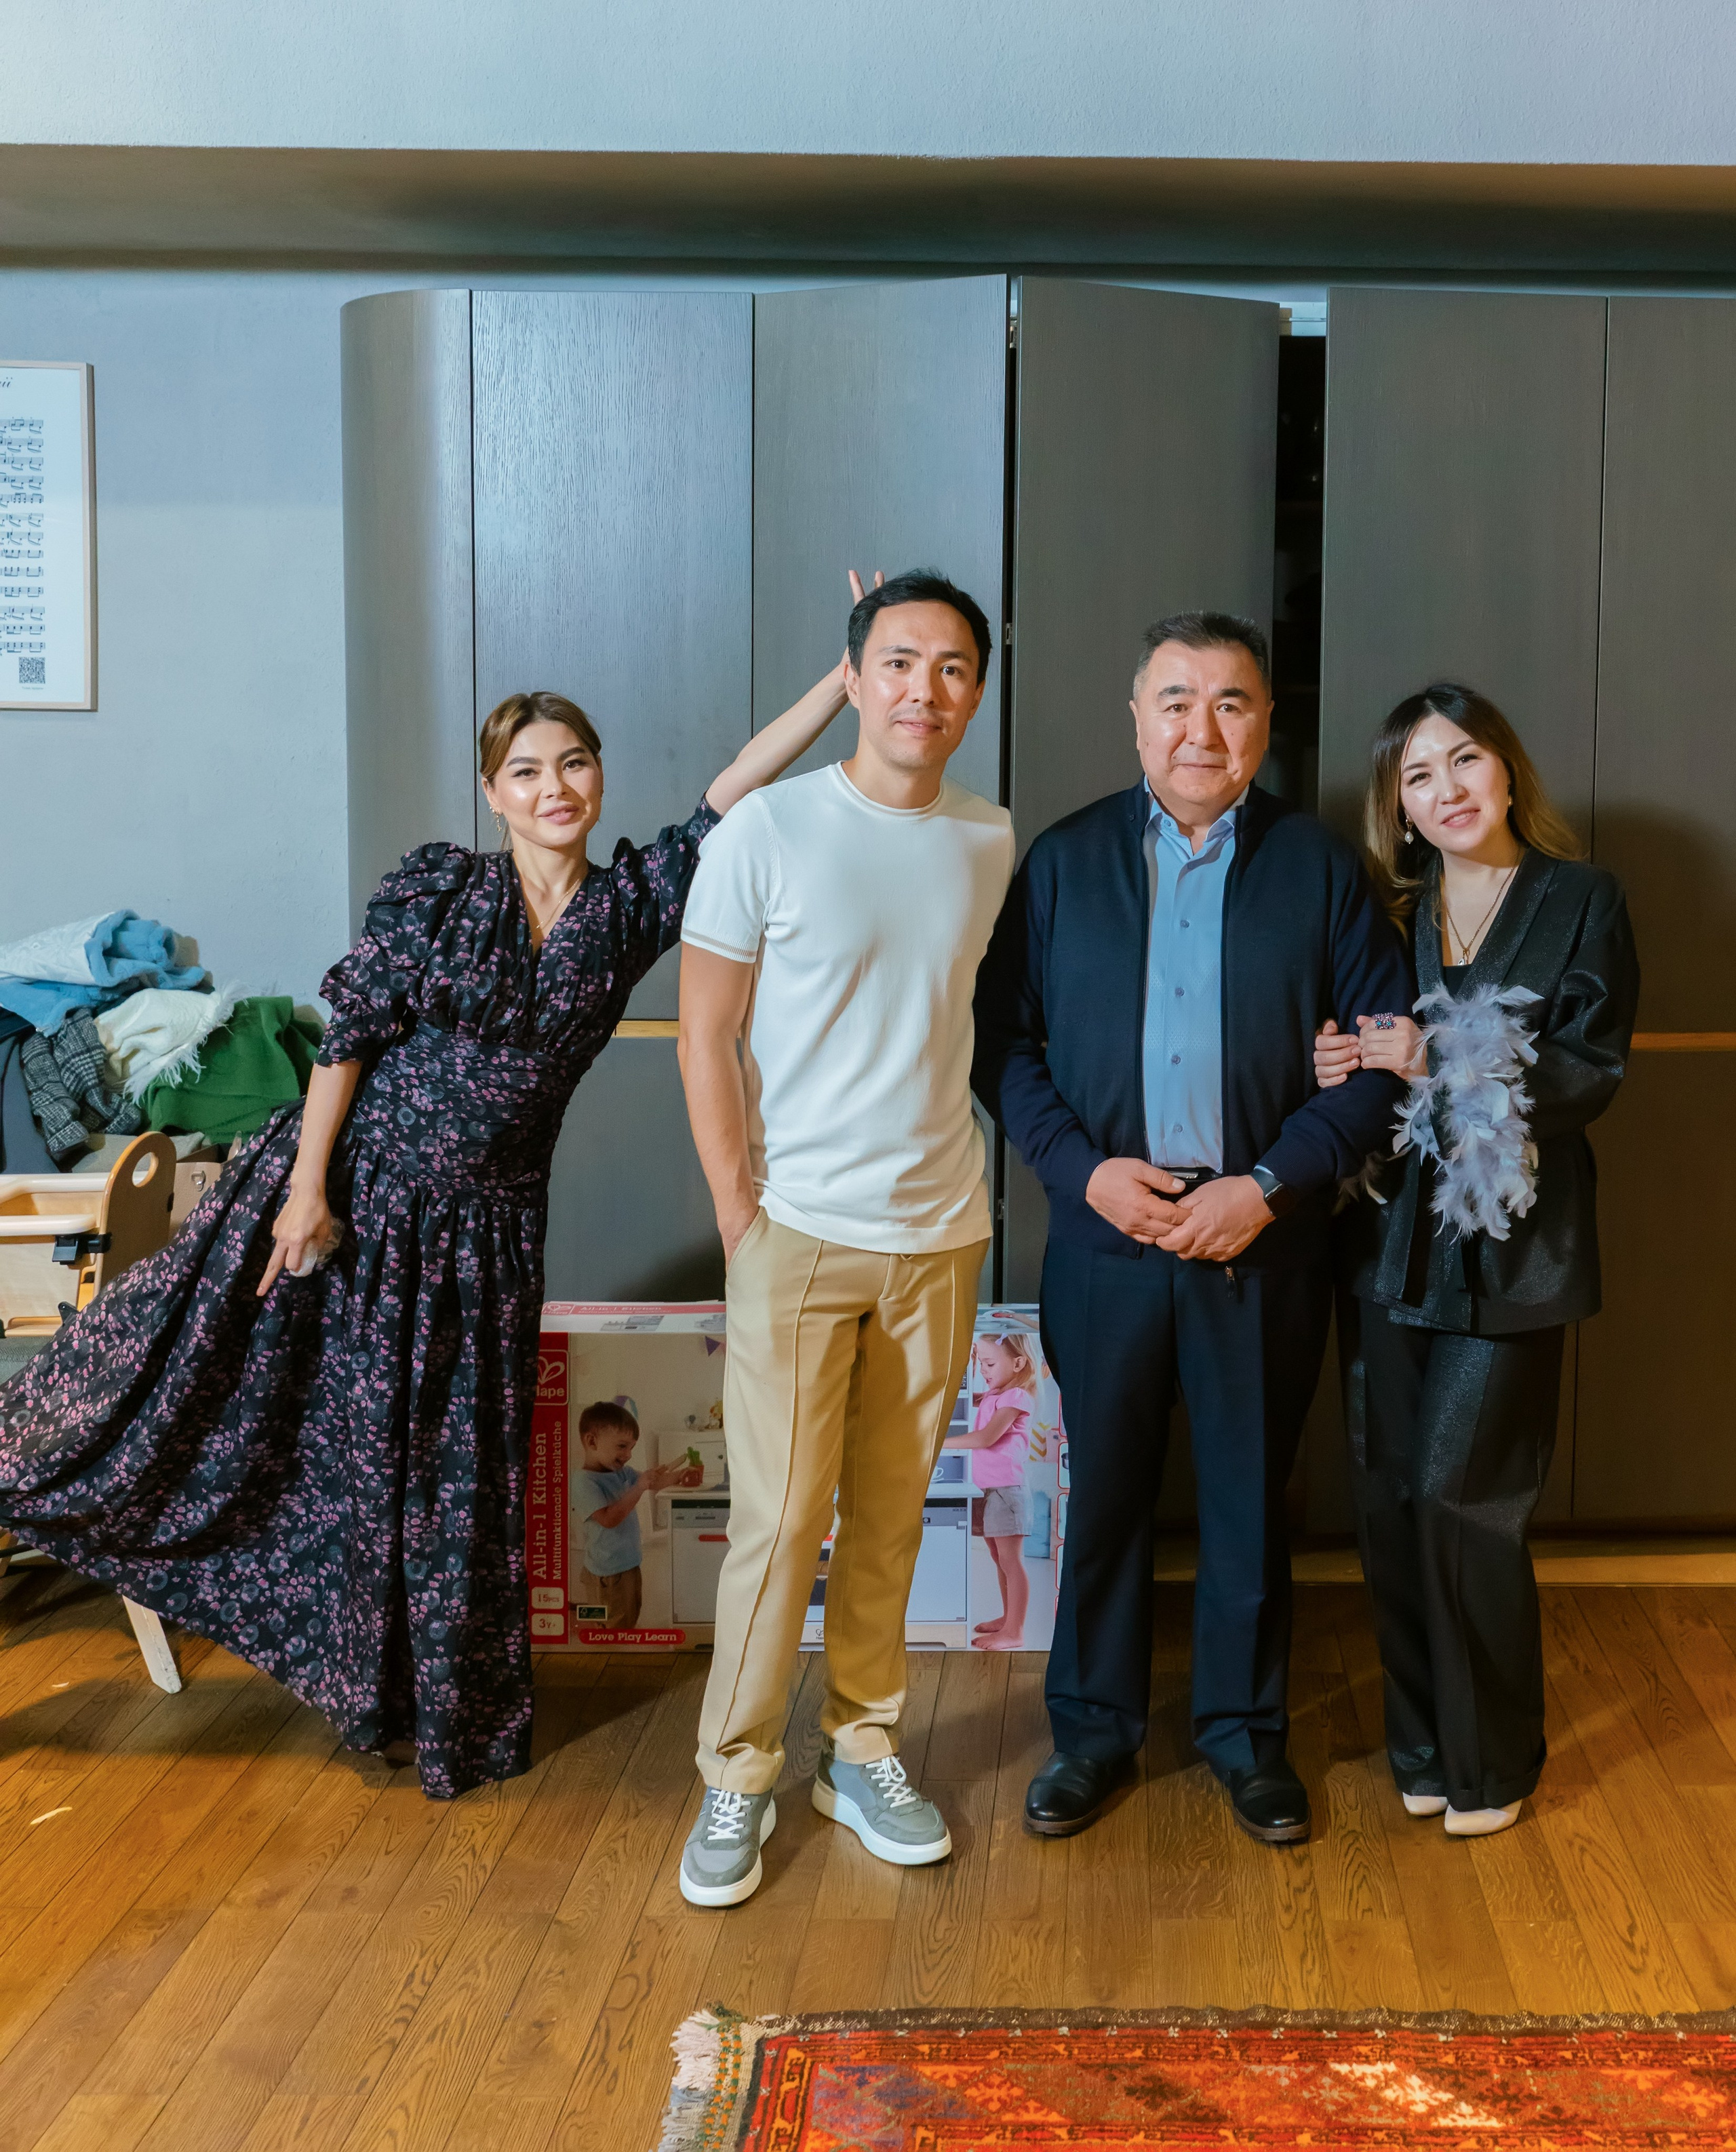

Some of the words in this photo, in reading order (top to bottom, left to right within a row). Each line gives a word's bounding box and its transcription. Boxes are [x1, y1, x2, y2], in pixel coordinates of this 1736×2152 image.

[532, 1433, 547, 1505] Kitchen
[553, 1420, 564, 1483] Spielküche
[532, 1513, 547, 1580] All-in-1
[553, 1486, 561, 1580] Multifunktionale
[589, 1632, 614, 1641] Love
[618, 1632, 642, 1643] Play
[645, 1632, 677, 1641] Learn
